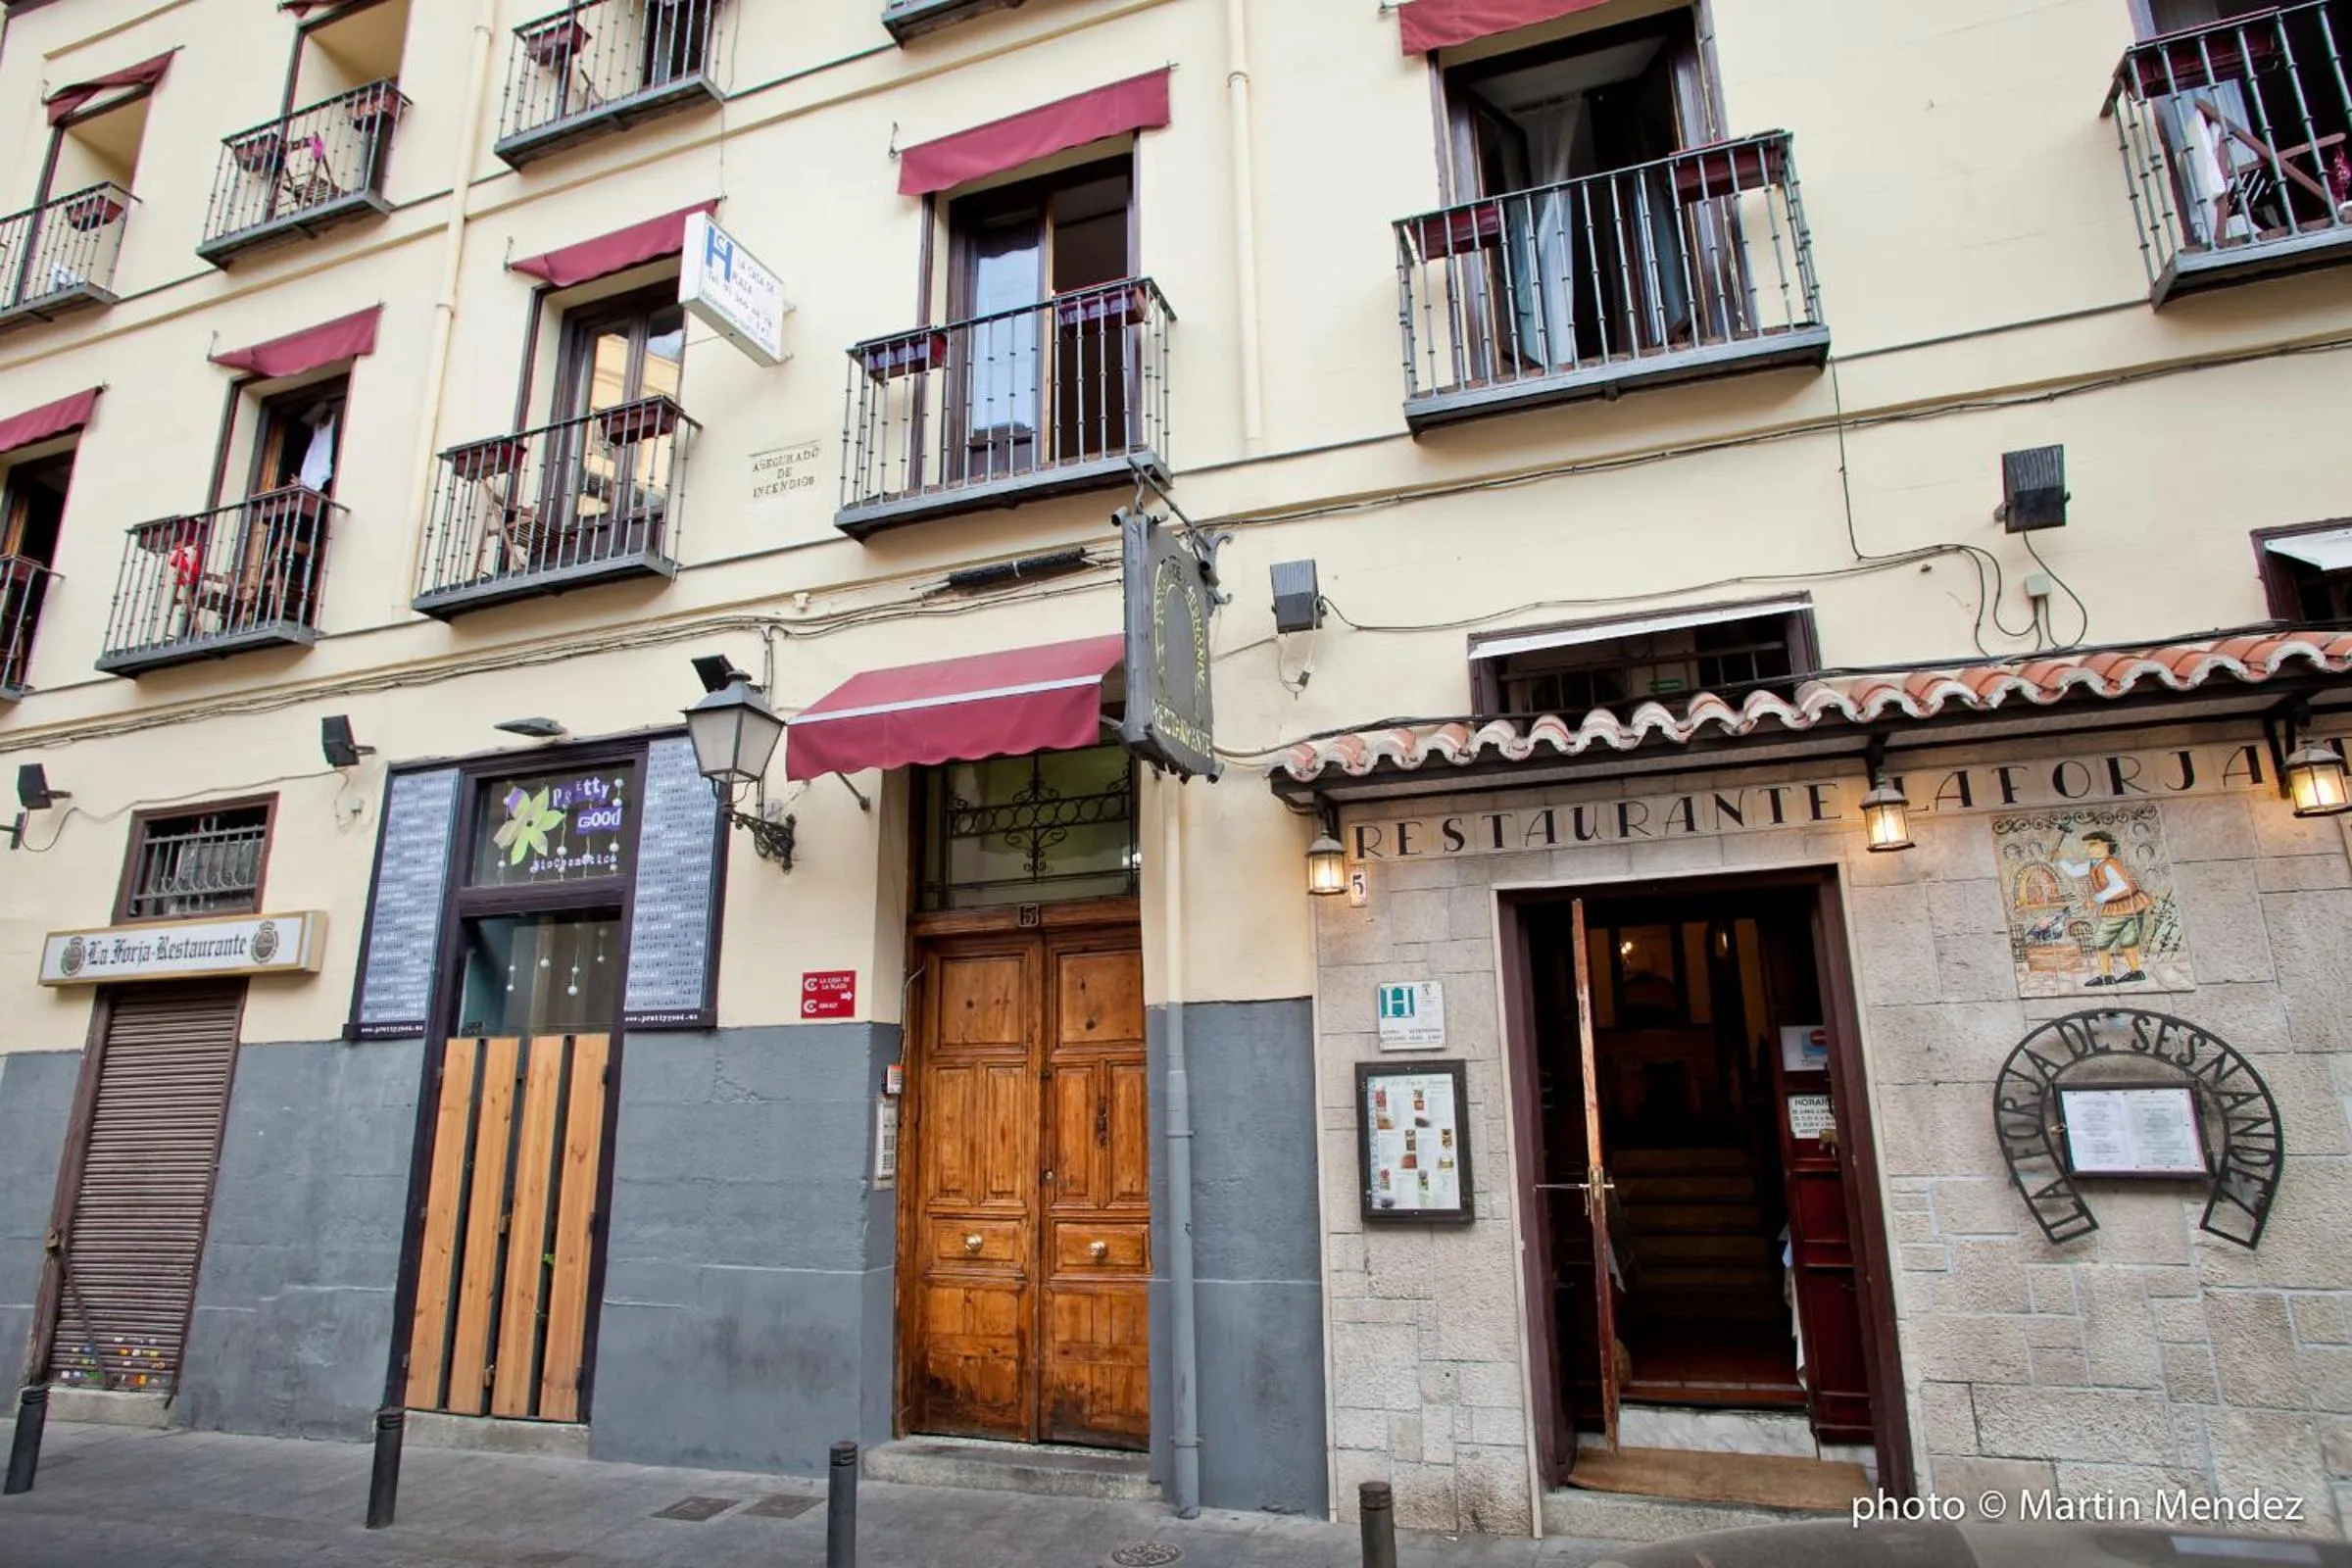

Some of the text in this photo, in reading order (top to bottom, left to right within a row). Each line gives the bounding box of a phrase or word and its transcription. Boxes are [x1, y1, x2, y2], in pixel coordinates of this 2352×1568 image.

[752, 446, 820, 472] ASEGURADO
[777, 466, 793, 479] DE
[1351, 783, 1843, 860] RESTAURANTE
[1351, 874, 1364, 896] 5
[2057, 1015, 2111, 1059] DE
[2032, 1177, 2087, 1230] LA
